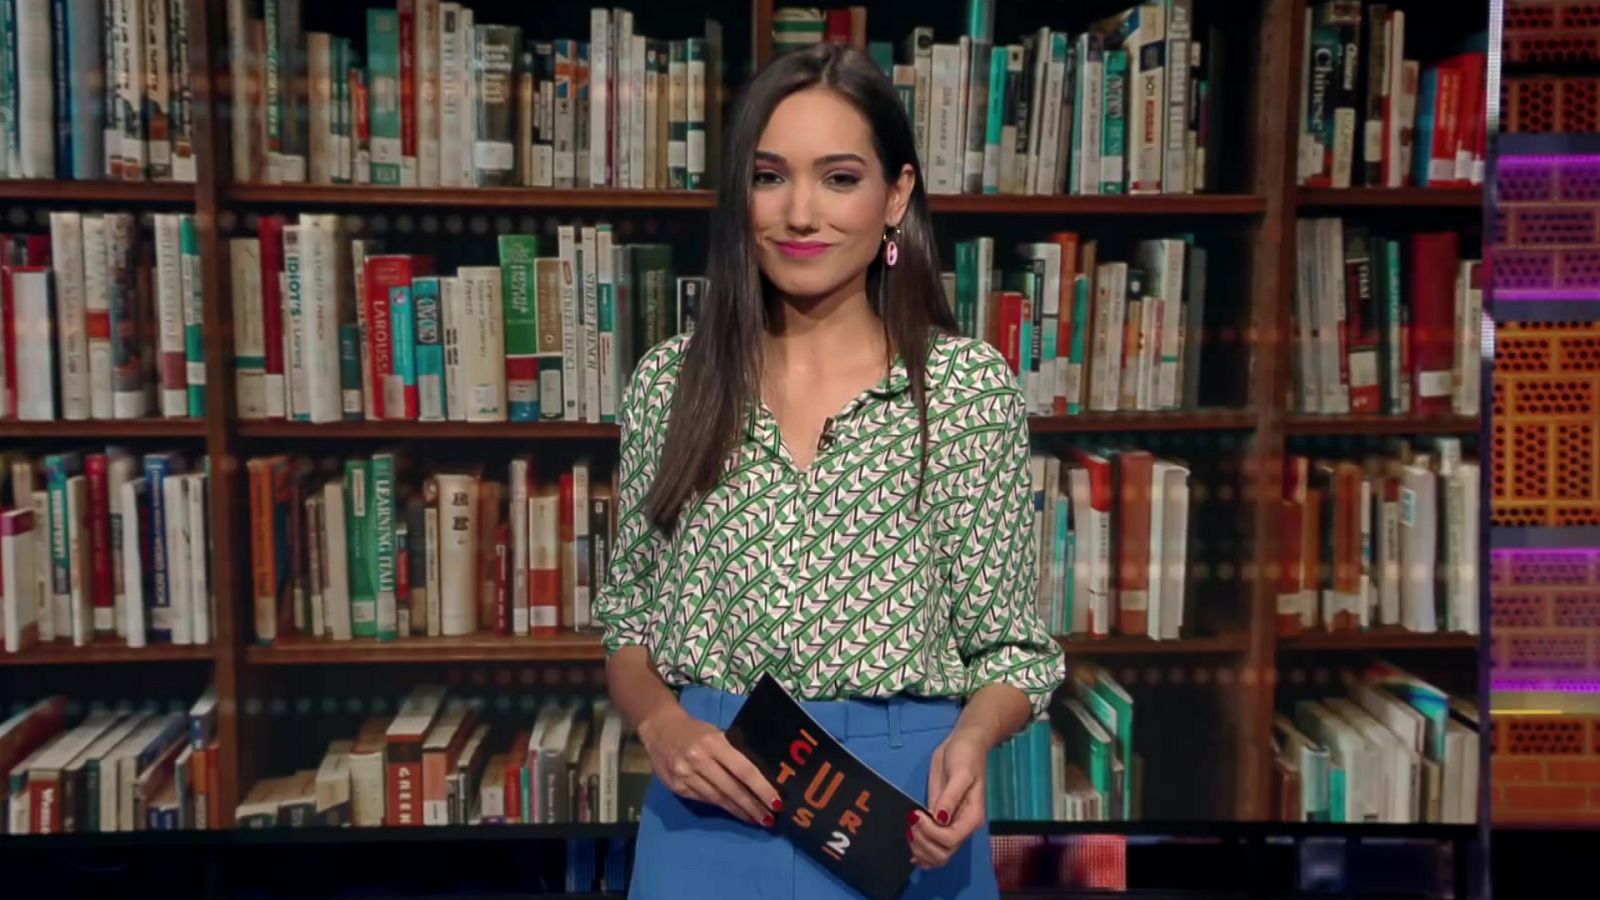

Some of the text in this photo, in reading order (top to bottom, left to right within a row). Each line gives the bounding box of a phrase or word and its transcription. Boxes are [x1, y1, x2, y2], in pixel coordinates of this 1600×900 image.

[1312, 47, 1334, 130] Chinese
[288, 257, 302, 316] IDIOT'S
[586, 272, 597, 369] STREET FRENCH
[374, 479, 391, 551] LEARNING
[398, 767, 412, 824] GREEK
[826, 831, 850, 855] 2
